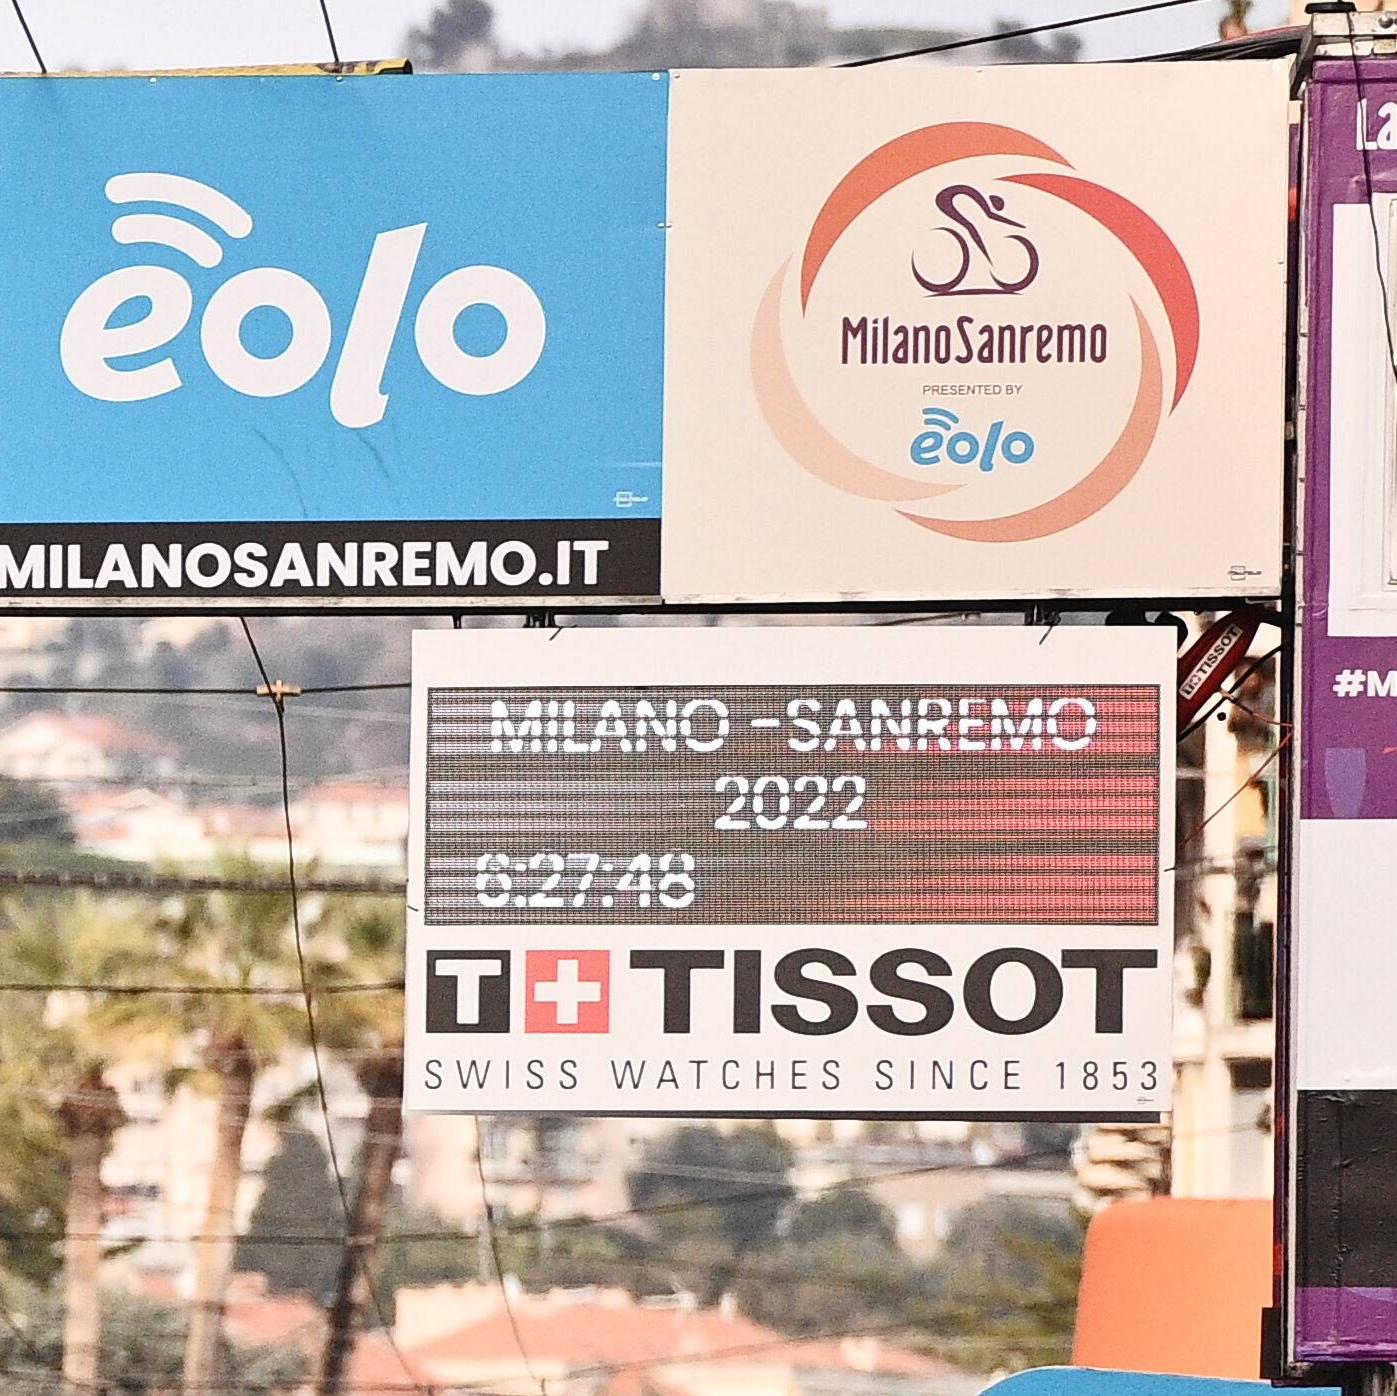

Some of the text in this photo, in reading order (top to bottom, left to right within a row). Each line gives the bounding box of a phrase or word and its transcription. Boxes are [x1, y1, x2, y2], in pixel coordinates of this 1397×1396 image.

[60, 223, 546, 428] eolo
[841, 316, 1107, 365] MilanoSanremo
[922, 384, 1023, 396] PRESENTED BY
[912, 422, 1035, 471] eolo
[1198, 625, 1239, 677] TISSOT
[490, 698, 729, 752] MILANO
[713, 775, 869, 830] 2022
[475, 853, 696, 908] 6:27:48
[629, 948, 1158, 1036] TISSOT
[424, 1059, 1160, 1091] SWISS WATCHES SINCE 1853
